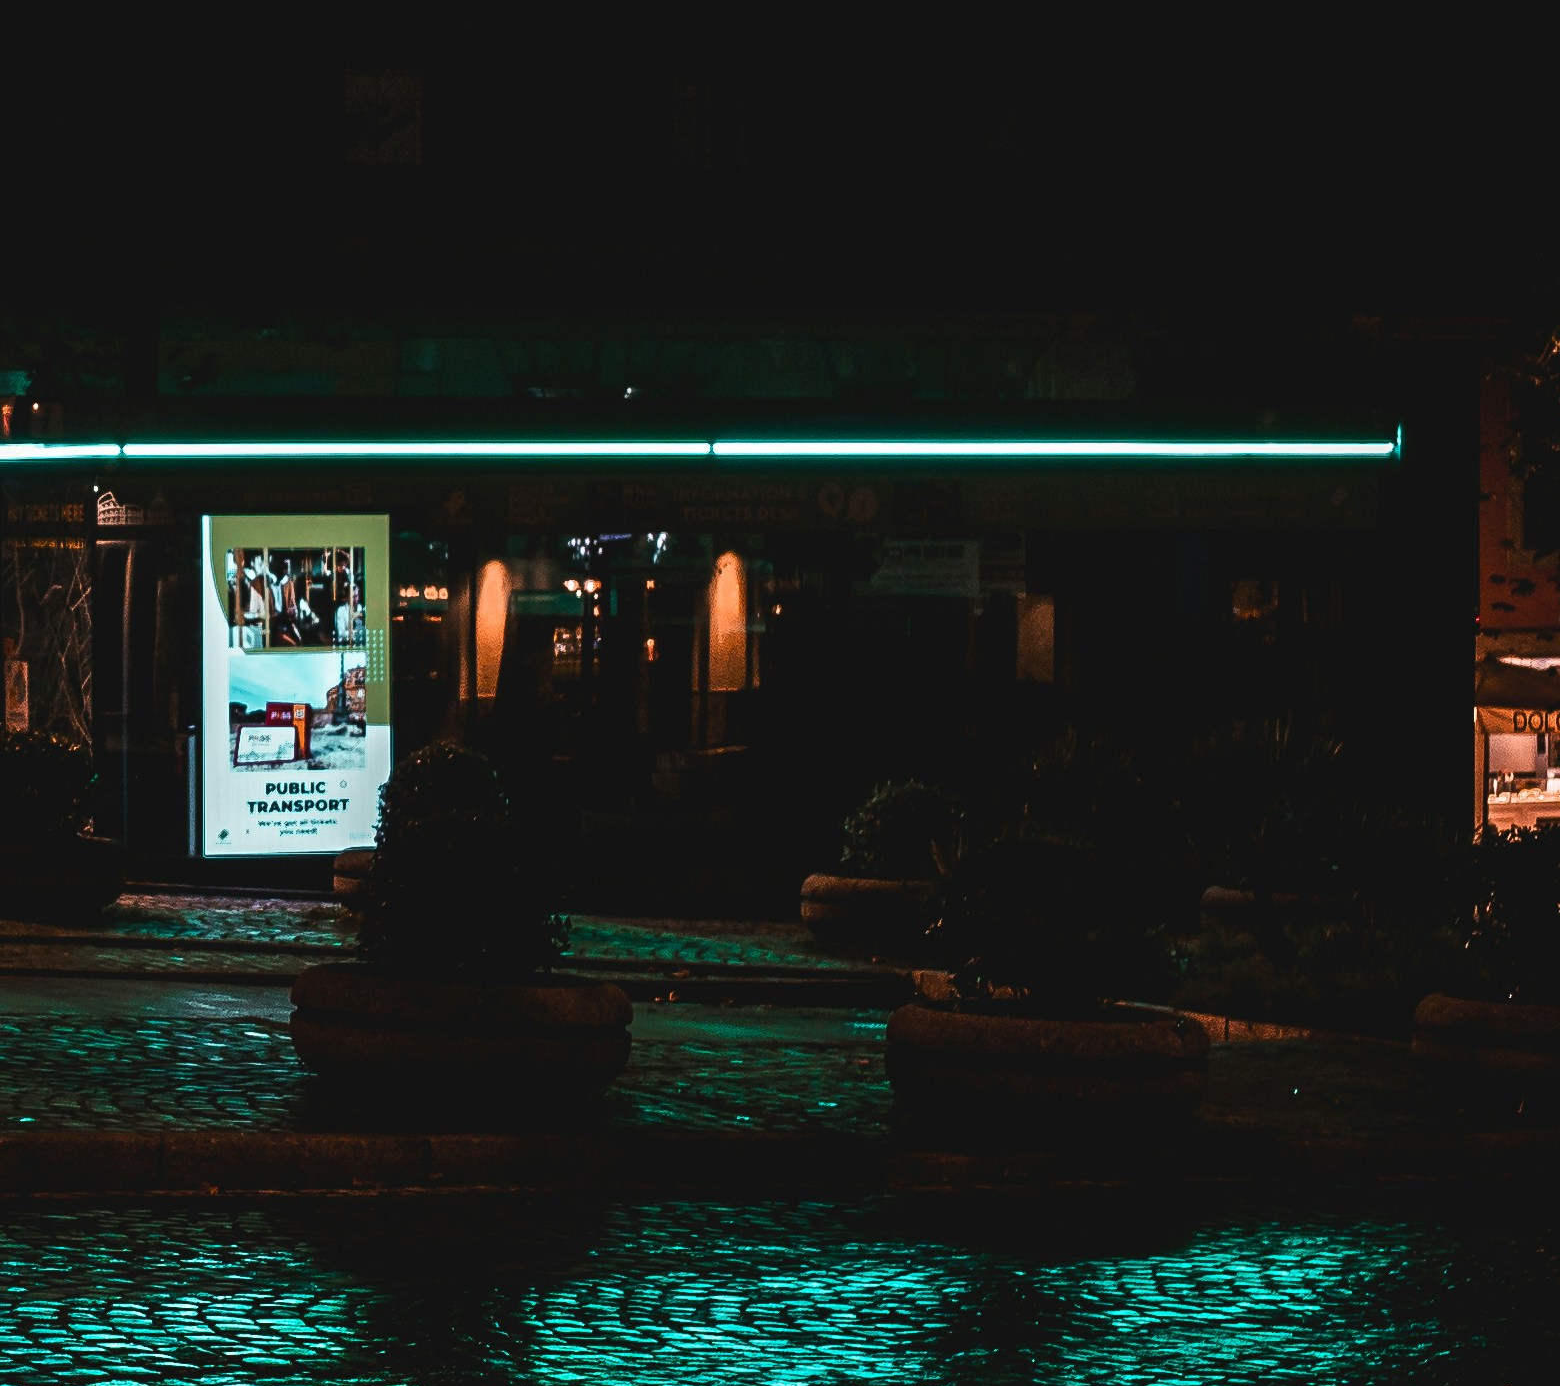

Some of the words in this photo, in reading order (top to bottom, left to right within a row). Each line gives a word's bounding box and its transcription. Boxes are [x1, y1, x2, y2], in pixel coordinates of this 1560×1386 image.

[265, 781, 326, 795] PUBLIC
[246, 798, 350, 813] TRANSPORT
[257, 819, 281, 827] We've
[284, 820, 297, 828] got
[279, 829, 294, 837] you
